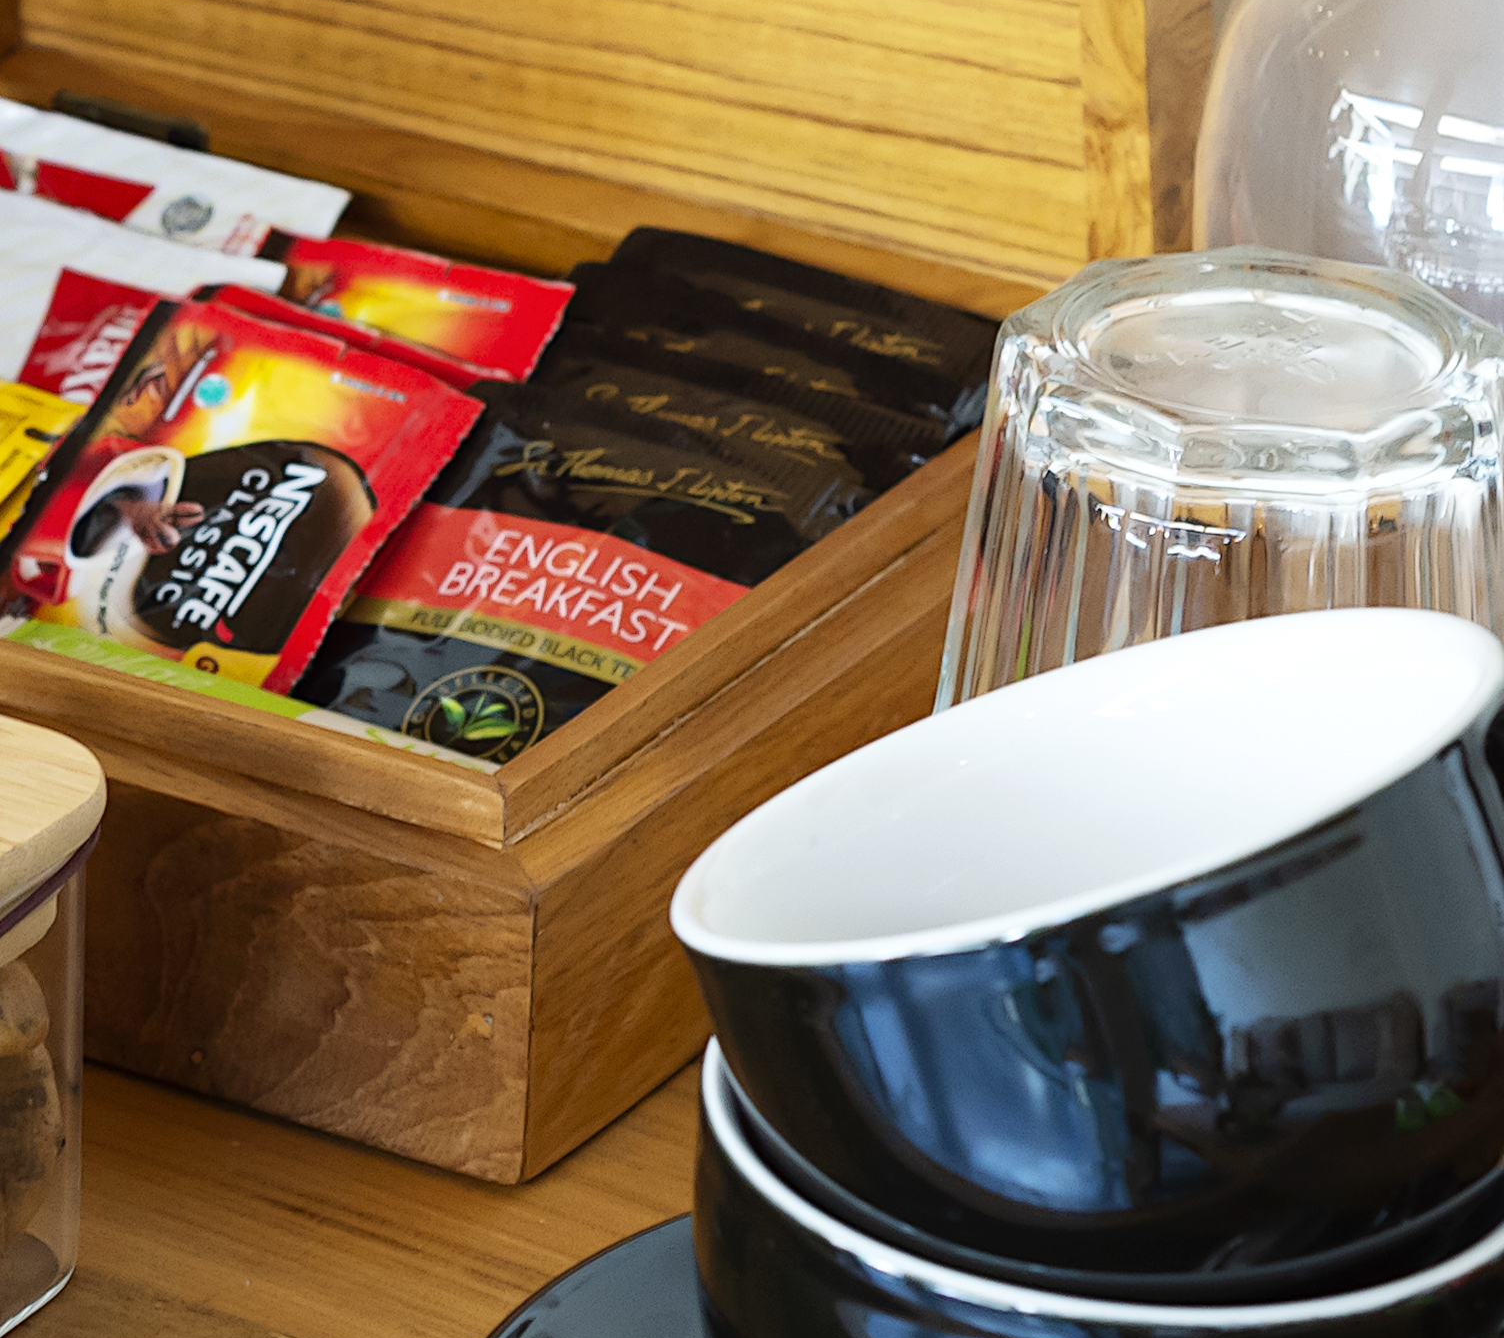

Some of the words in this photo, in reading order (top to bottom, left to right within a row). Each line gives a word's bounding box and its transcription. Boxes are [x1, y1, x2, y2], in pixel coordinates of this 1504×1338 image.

[156, 467, 272, 604] CLASSIC
[484, 529, 684, 612] ENGLISH
[438, 560, 689, 652] BREAKFAST
[458, 616, 537, 651] BODIED
[540, 638, 607, 670] BLACK
